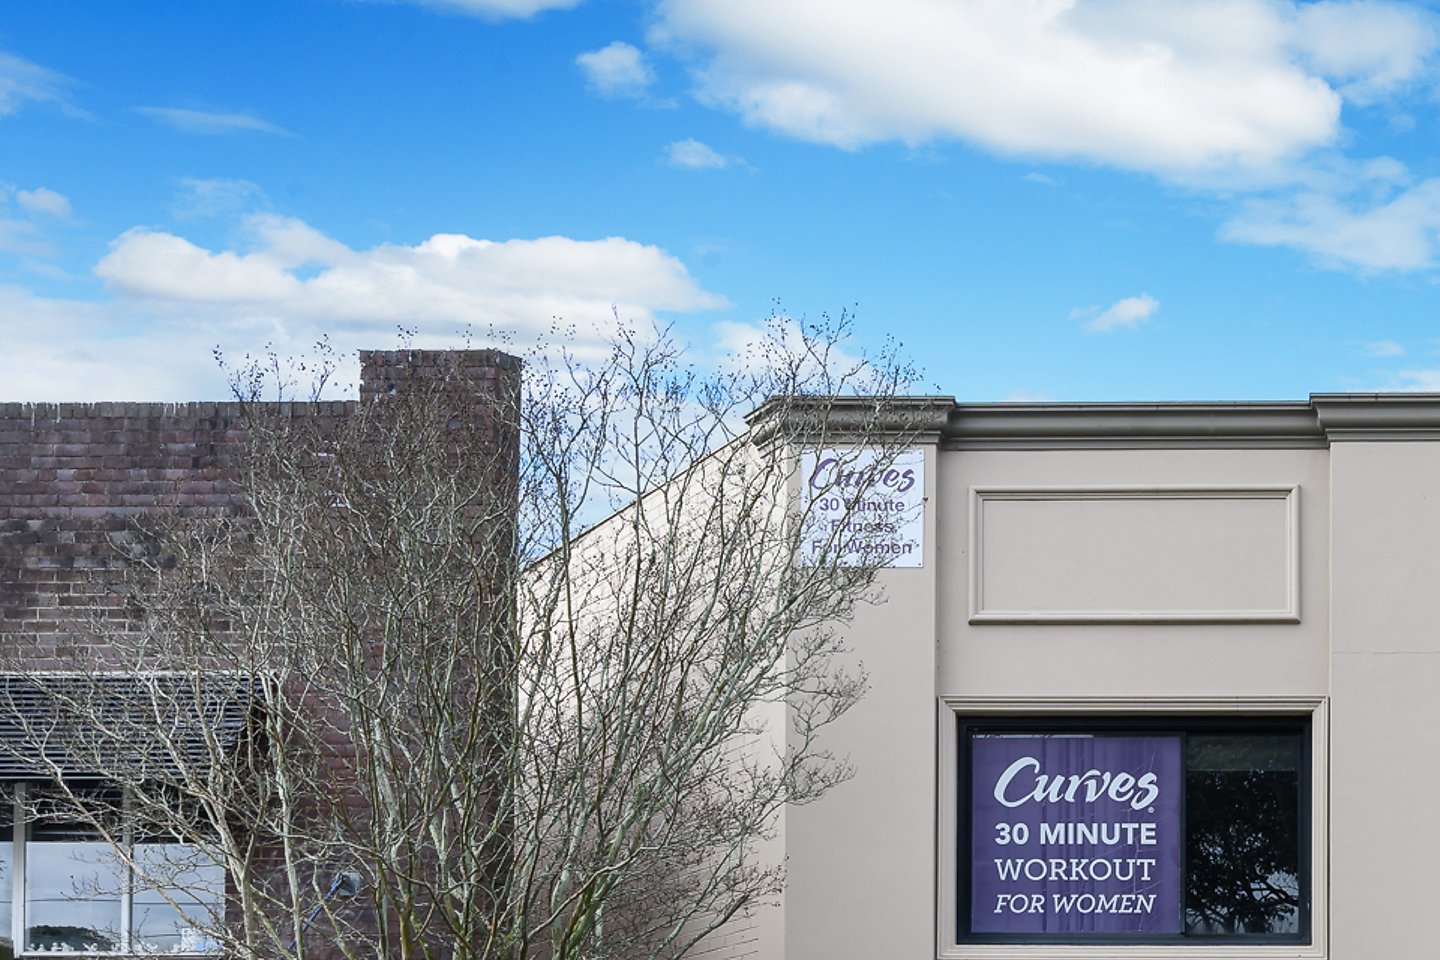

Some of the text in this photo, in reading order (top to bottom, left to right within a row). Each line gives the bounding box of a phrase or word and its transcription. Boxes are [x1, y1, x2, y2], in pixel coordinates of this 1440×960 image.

[820, 498, 839, 511] 30
[994, 756, 1159, 810] Curves
[994, 823, 1157, 845] 30 MINUTE
[994, 858, 1156, 881] WORKOUT
[994, 894, 1156, 914] FOR WOMEN
